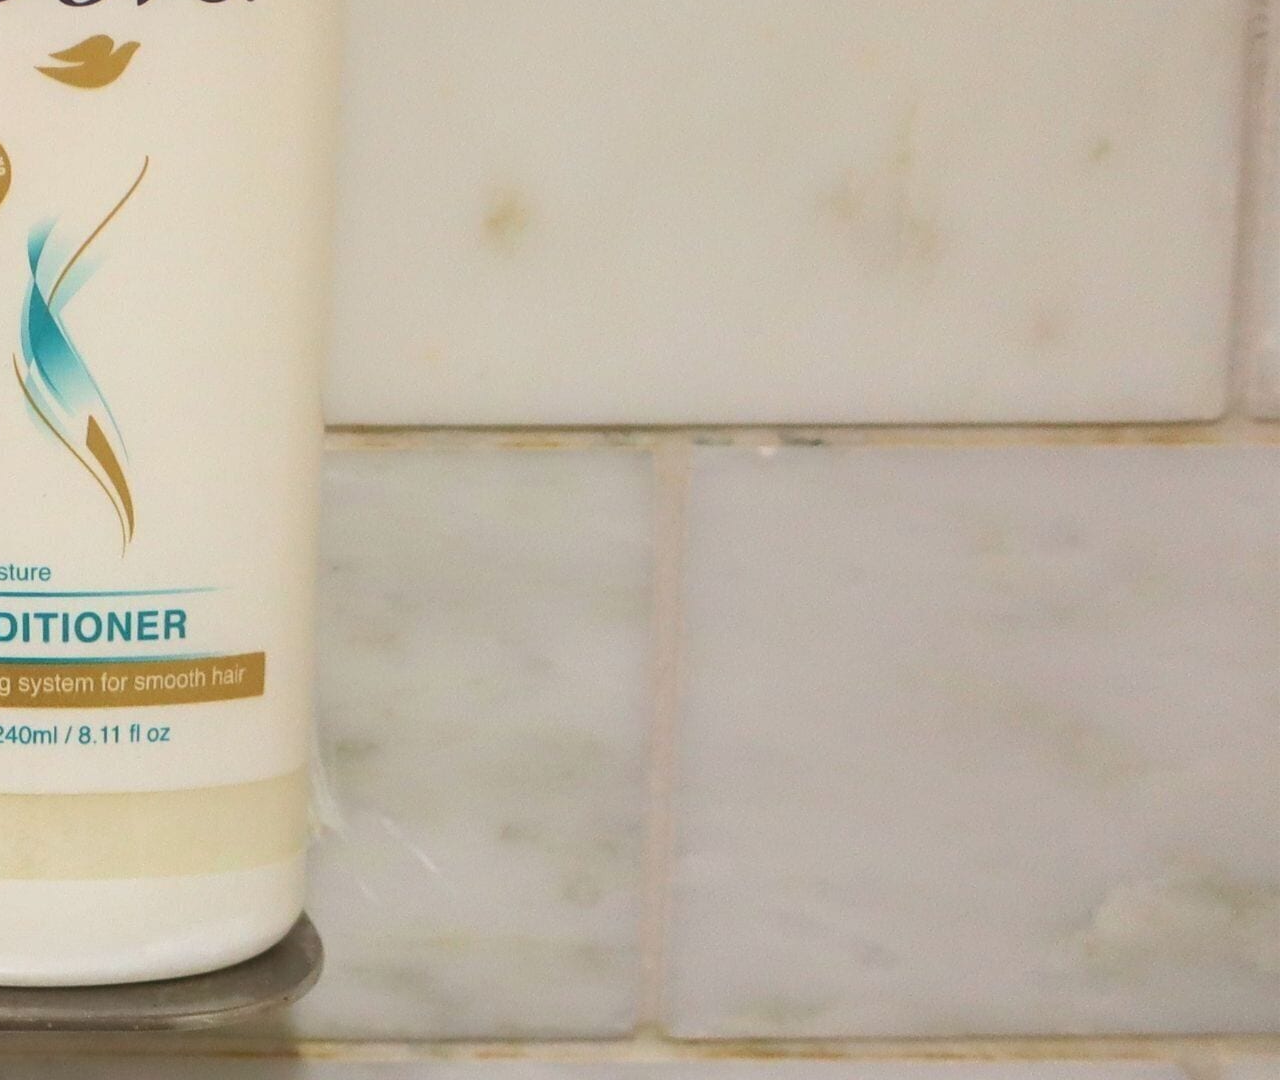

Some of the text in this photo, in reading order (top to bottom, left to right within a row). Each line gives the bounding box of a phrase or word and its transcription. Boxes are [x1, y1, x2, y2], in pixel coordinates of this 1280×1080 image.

[18, 674, 94, 697] system
[100, 672, 128, 692] for
[134, 666, 206, 691] smooth
[211, 664, 247, 686] hair
[78, 724, 120, 745] 8.11
[129, 723, 141, 743] fl
[146, 726, 170, 743] oz
